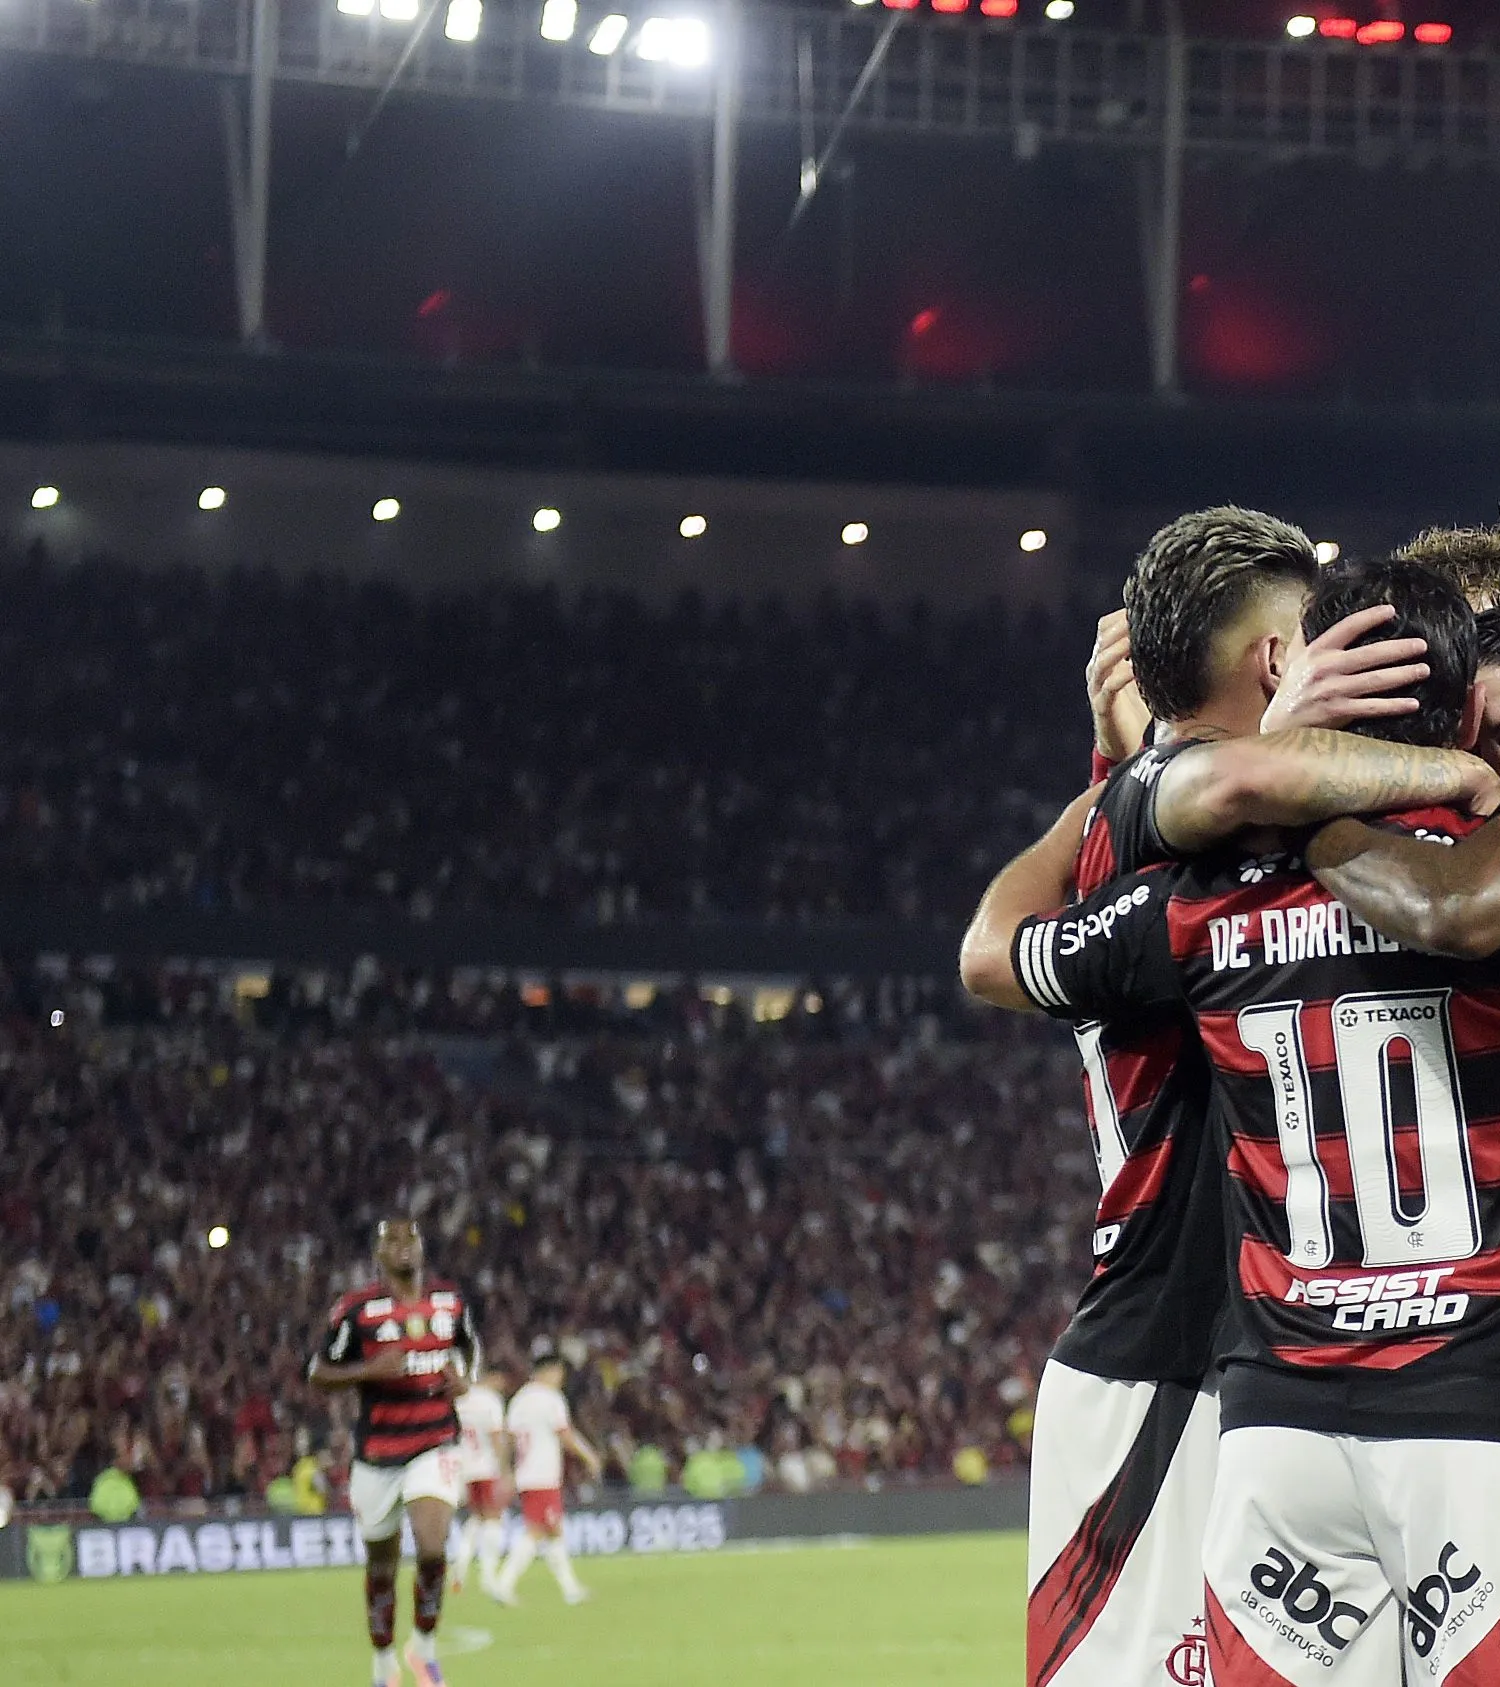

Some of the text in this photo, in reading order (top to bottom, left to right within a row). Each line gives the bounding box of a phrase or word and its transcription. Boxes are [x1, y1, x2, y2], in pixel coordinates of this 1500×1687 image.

[1207, 913, 1251, 972] DE
[1363, 1004, 1436, 1024] TEXACO
[1274, 1030, 1297, 1106] TEXACO
[1237, 987, 1483, 1270] 10
[1284, 1267, 1456, 1307] ASSIST
[1331, 1293, 1470, 1332] CARD
[1240, 1589, 1259, 1610] da
[1258, 1604, 1334, 1669] construção
[1250, 1546, 1369, 1650] abc
[1407, 1540, 1482, 1658] abc
